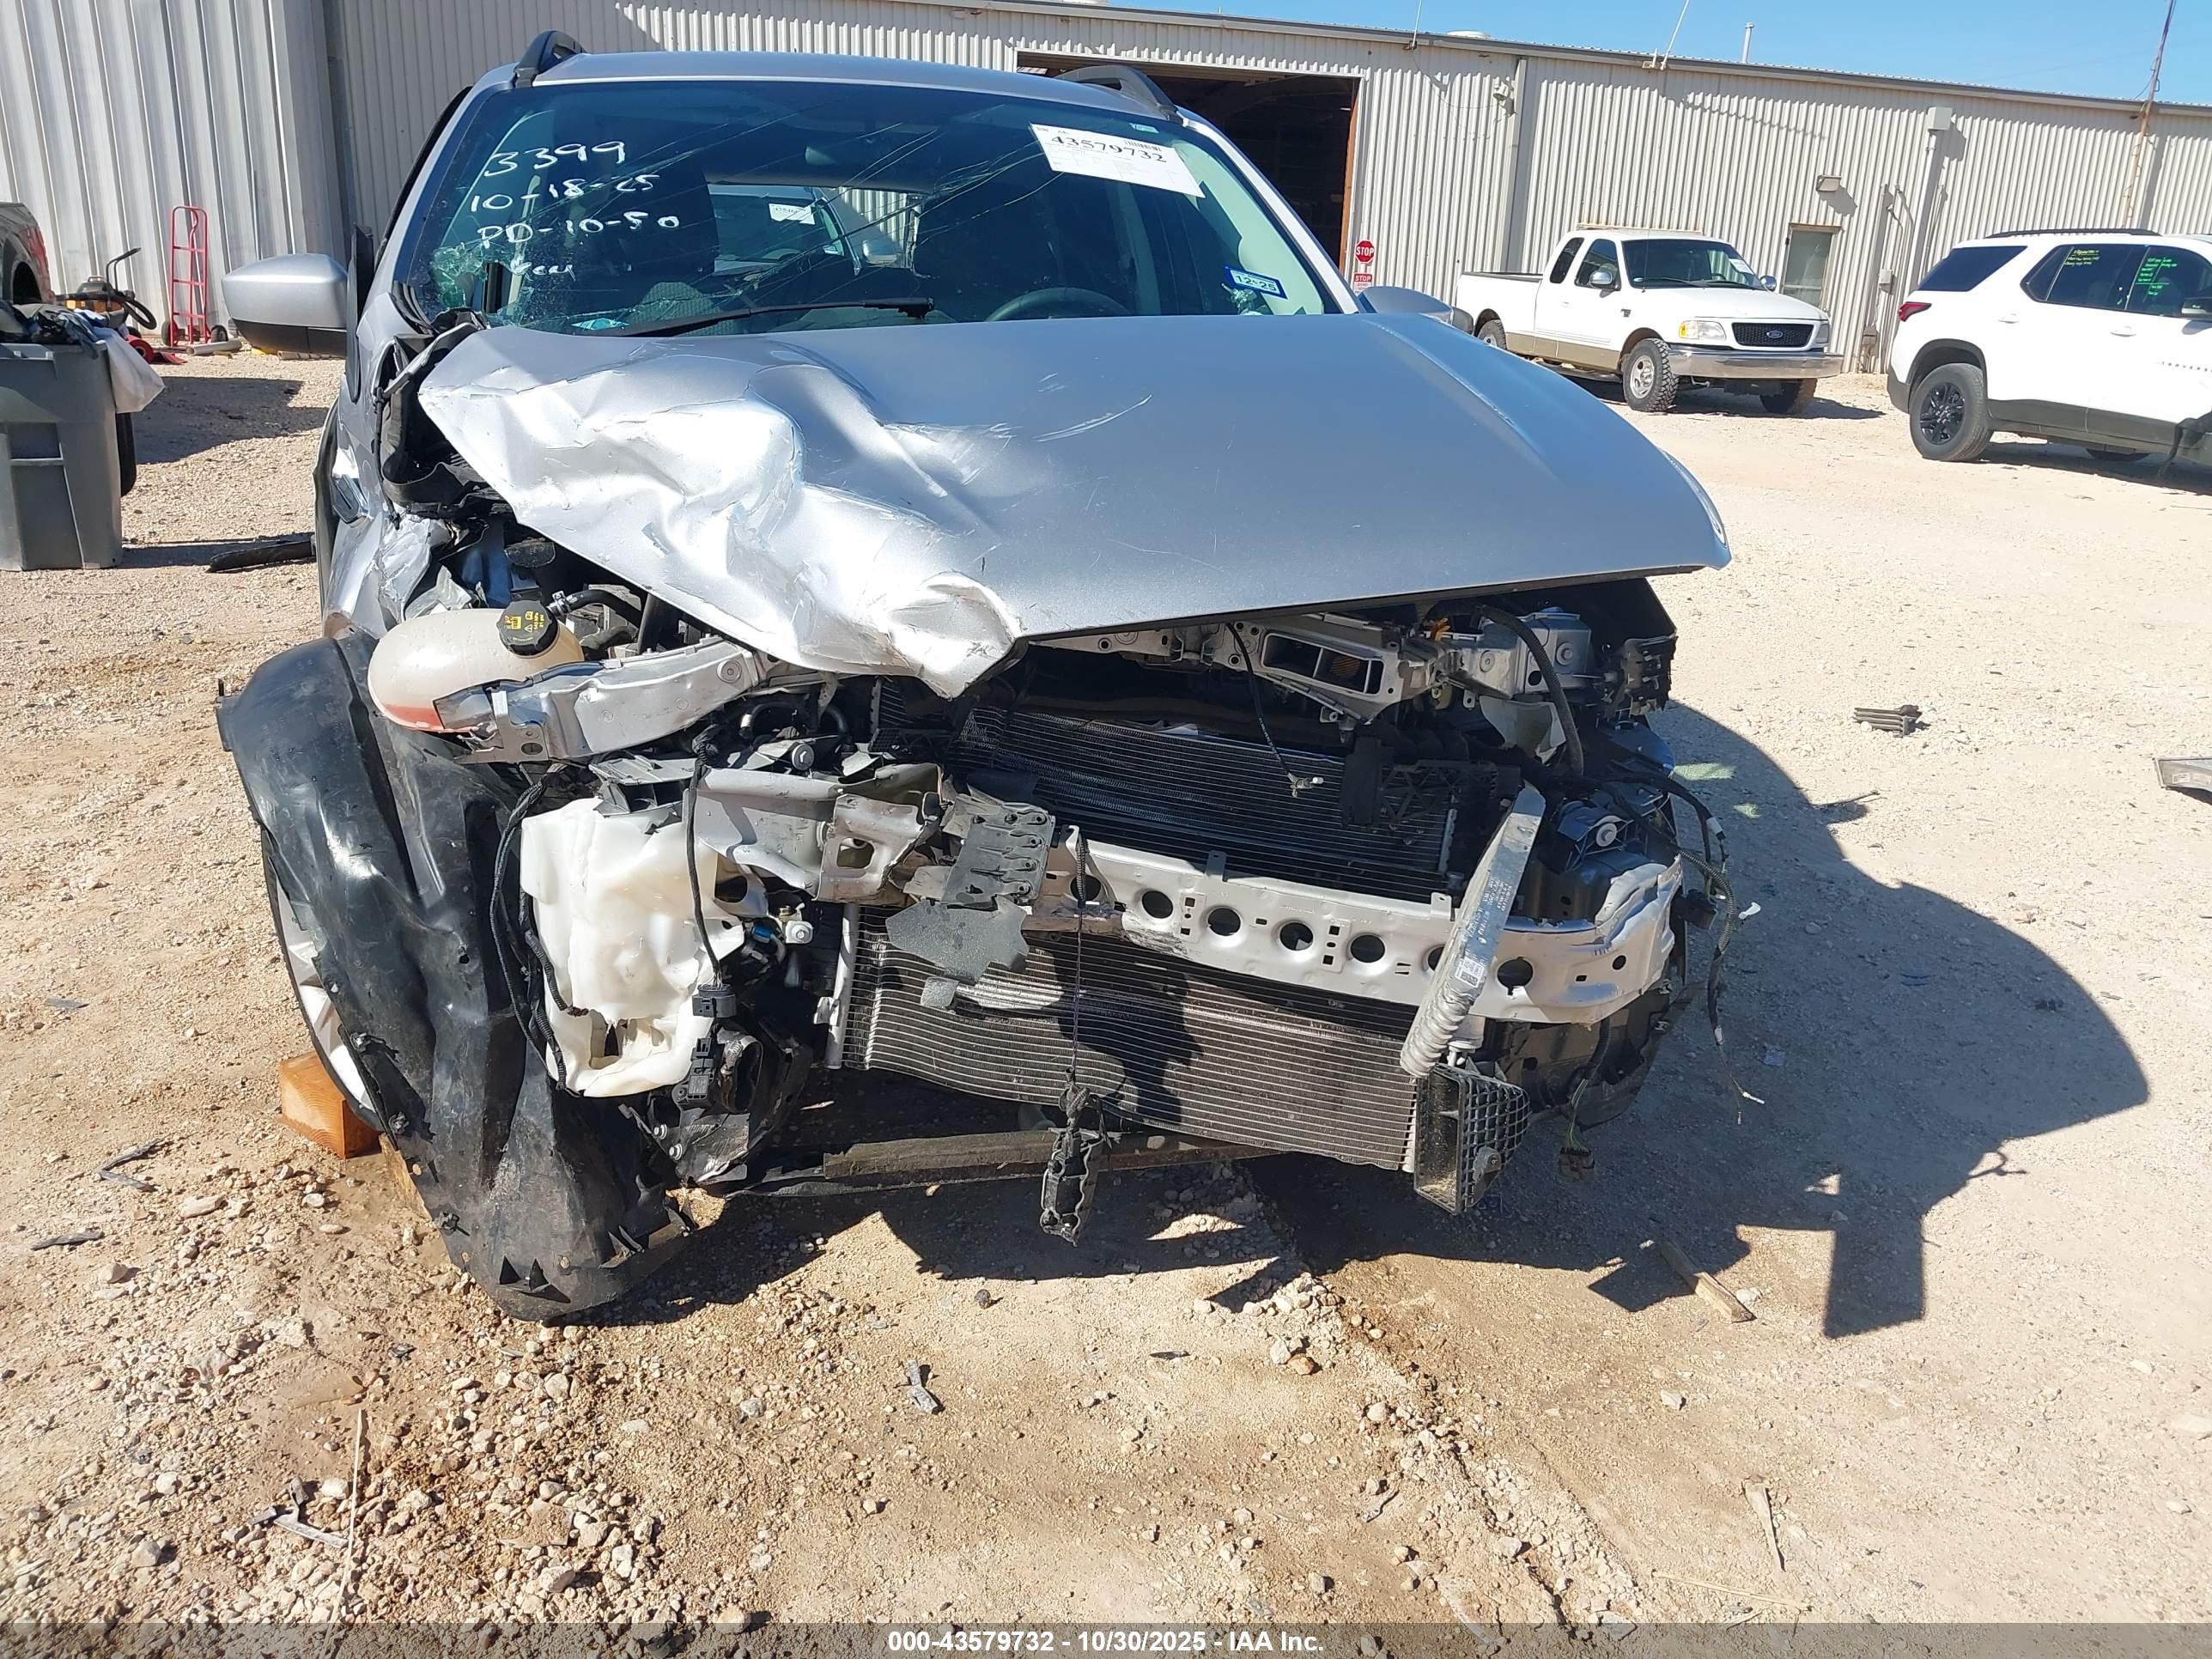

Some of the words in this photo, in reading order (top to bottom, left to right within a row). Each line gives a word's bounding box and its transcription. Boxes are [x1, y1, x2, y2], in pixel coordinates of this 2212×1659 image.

[483, 141, 626, 177] 3399
[1051, 136, 1167, 163] 43579732
[1357, 246, 1375, 258] STOP
